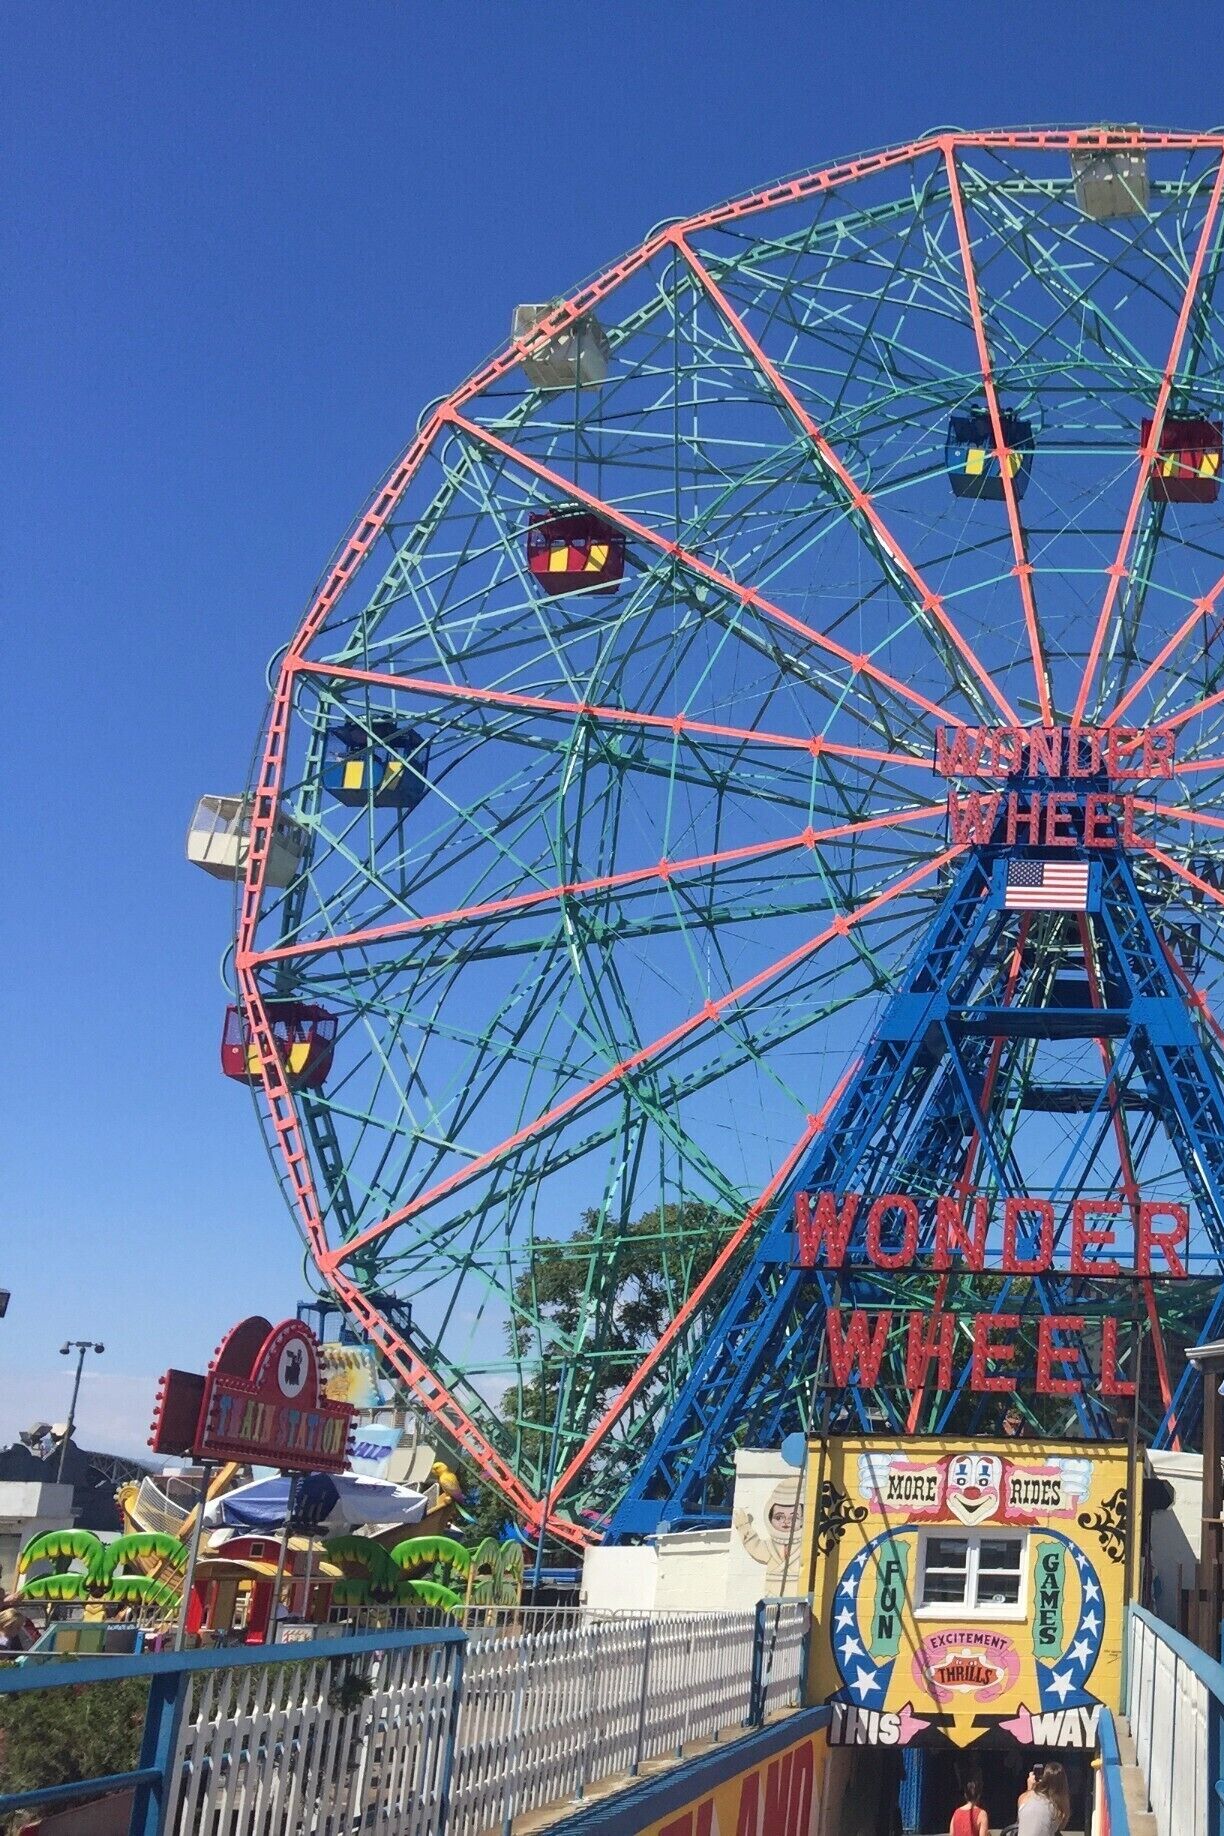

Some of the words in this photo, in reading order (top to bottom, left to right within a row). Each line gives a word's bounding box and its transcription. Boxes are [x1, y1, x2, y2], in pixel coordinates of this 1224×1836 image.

[936, 726, 1175, 779] WONDER
[949, 791, 1156, 847] WHEEL
[795, 1192, 1189, 1278] WONDER
[826, 1309, 1137, 1395] WHEEL
[218, 1396, 277, 1443] TRAIN
[279, 1407, 345, 1453] STATION
[887, 1475, 938, 1502] MORE
[1010, 1479, 1061, 1506] RIDES
[878, 1560, 900, 1639] FUN
[1039, 1553, 1061, 1645] GAMES
[930, 1632, 1008, 1651] EXCITEMENT
[938, 1664, 992, 1685] THRILLS
[830, 1701, 900, 1745] THIS
[1031, 1704, 1104, 1748] WAY
